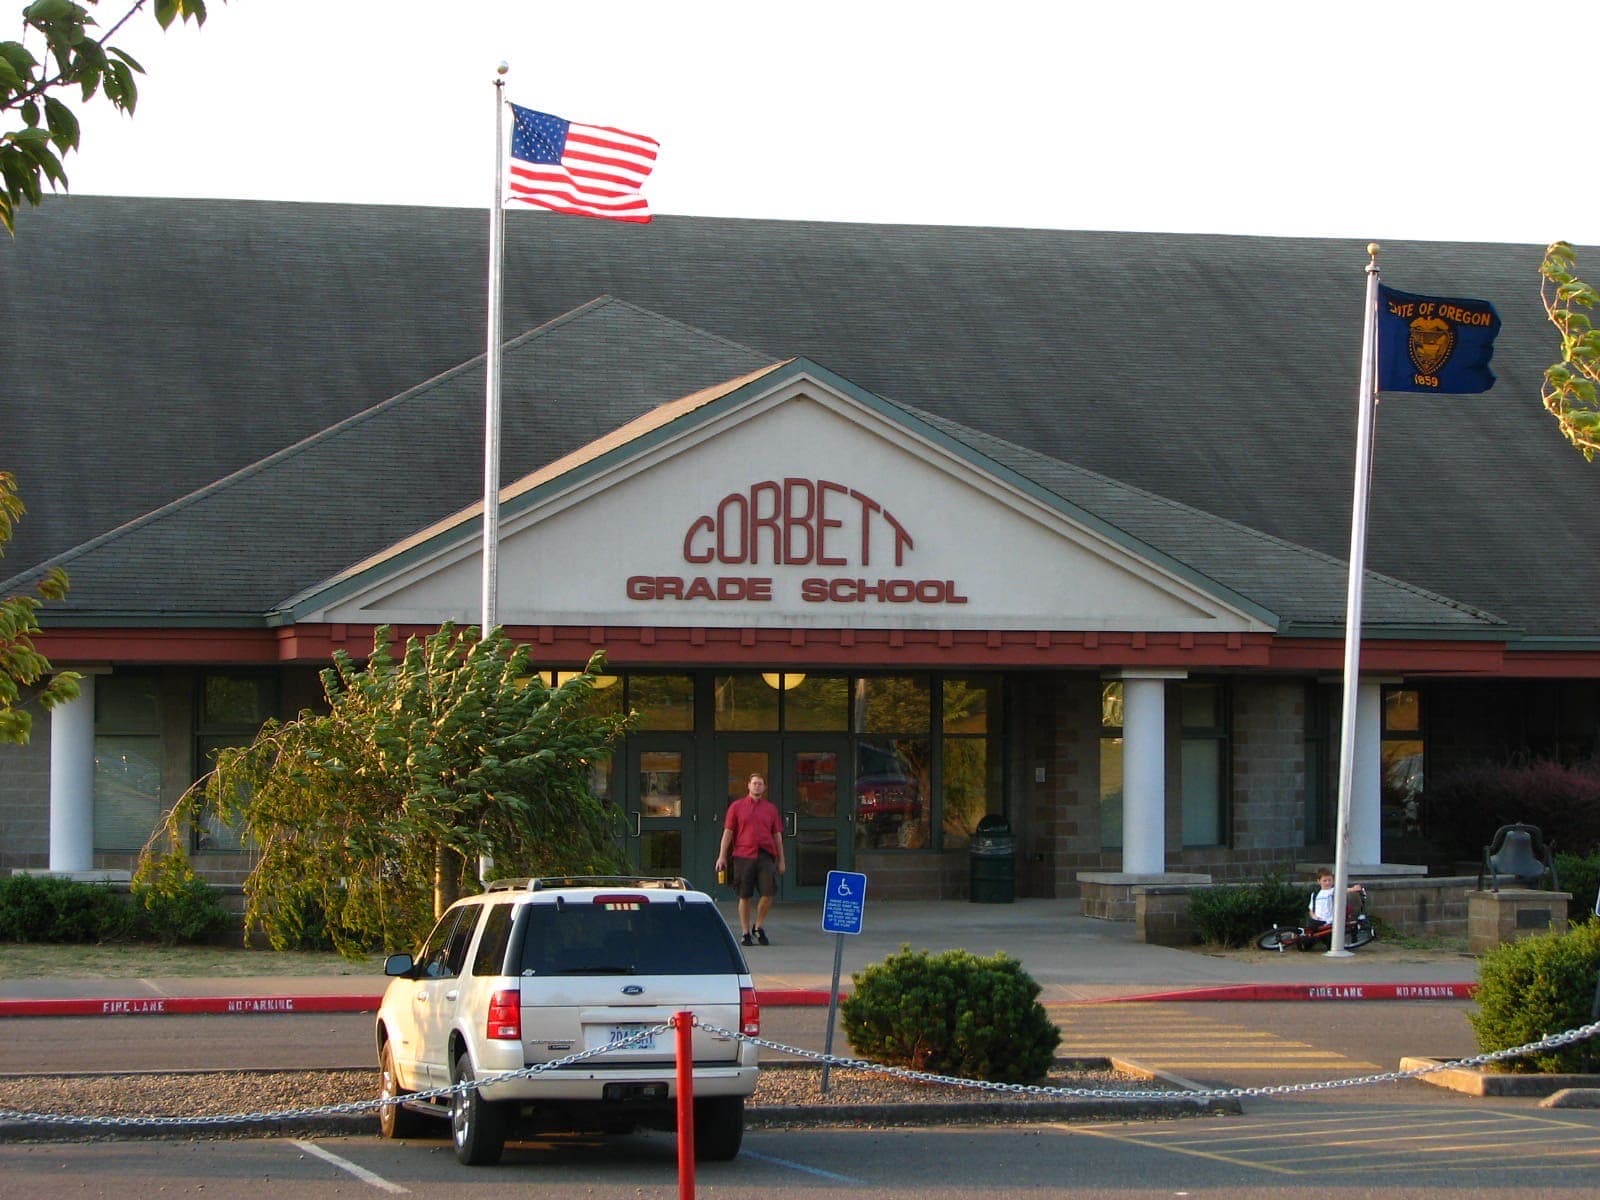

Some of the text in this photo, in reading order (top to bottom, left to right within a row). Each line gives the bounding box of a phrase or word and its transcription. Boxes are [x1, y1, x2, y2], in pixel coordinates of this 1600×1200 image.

[1418, 302, 1435, 315] OF
[1438, 304, 1491, 327] OREGON
[1415, 374, 1438, 387] 1859
[683, 478, 914, 567] CORBETT
[626, 576, 968, 604] GRADE SCHOOL
[1309, 987, 1363, 998] FIRE LANE
[1396, 986, 1409, 997] NO
[103, 1001, 165, 1013] FIRE LANE
[228, 999, 294, 1011] NO PARKING
